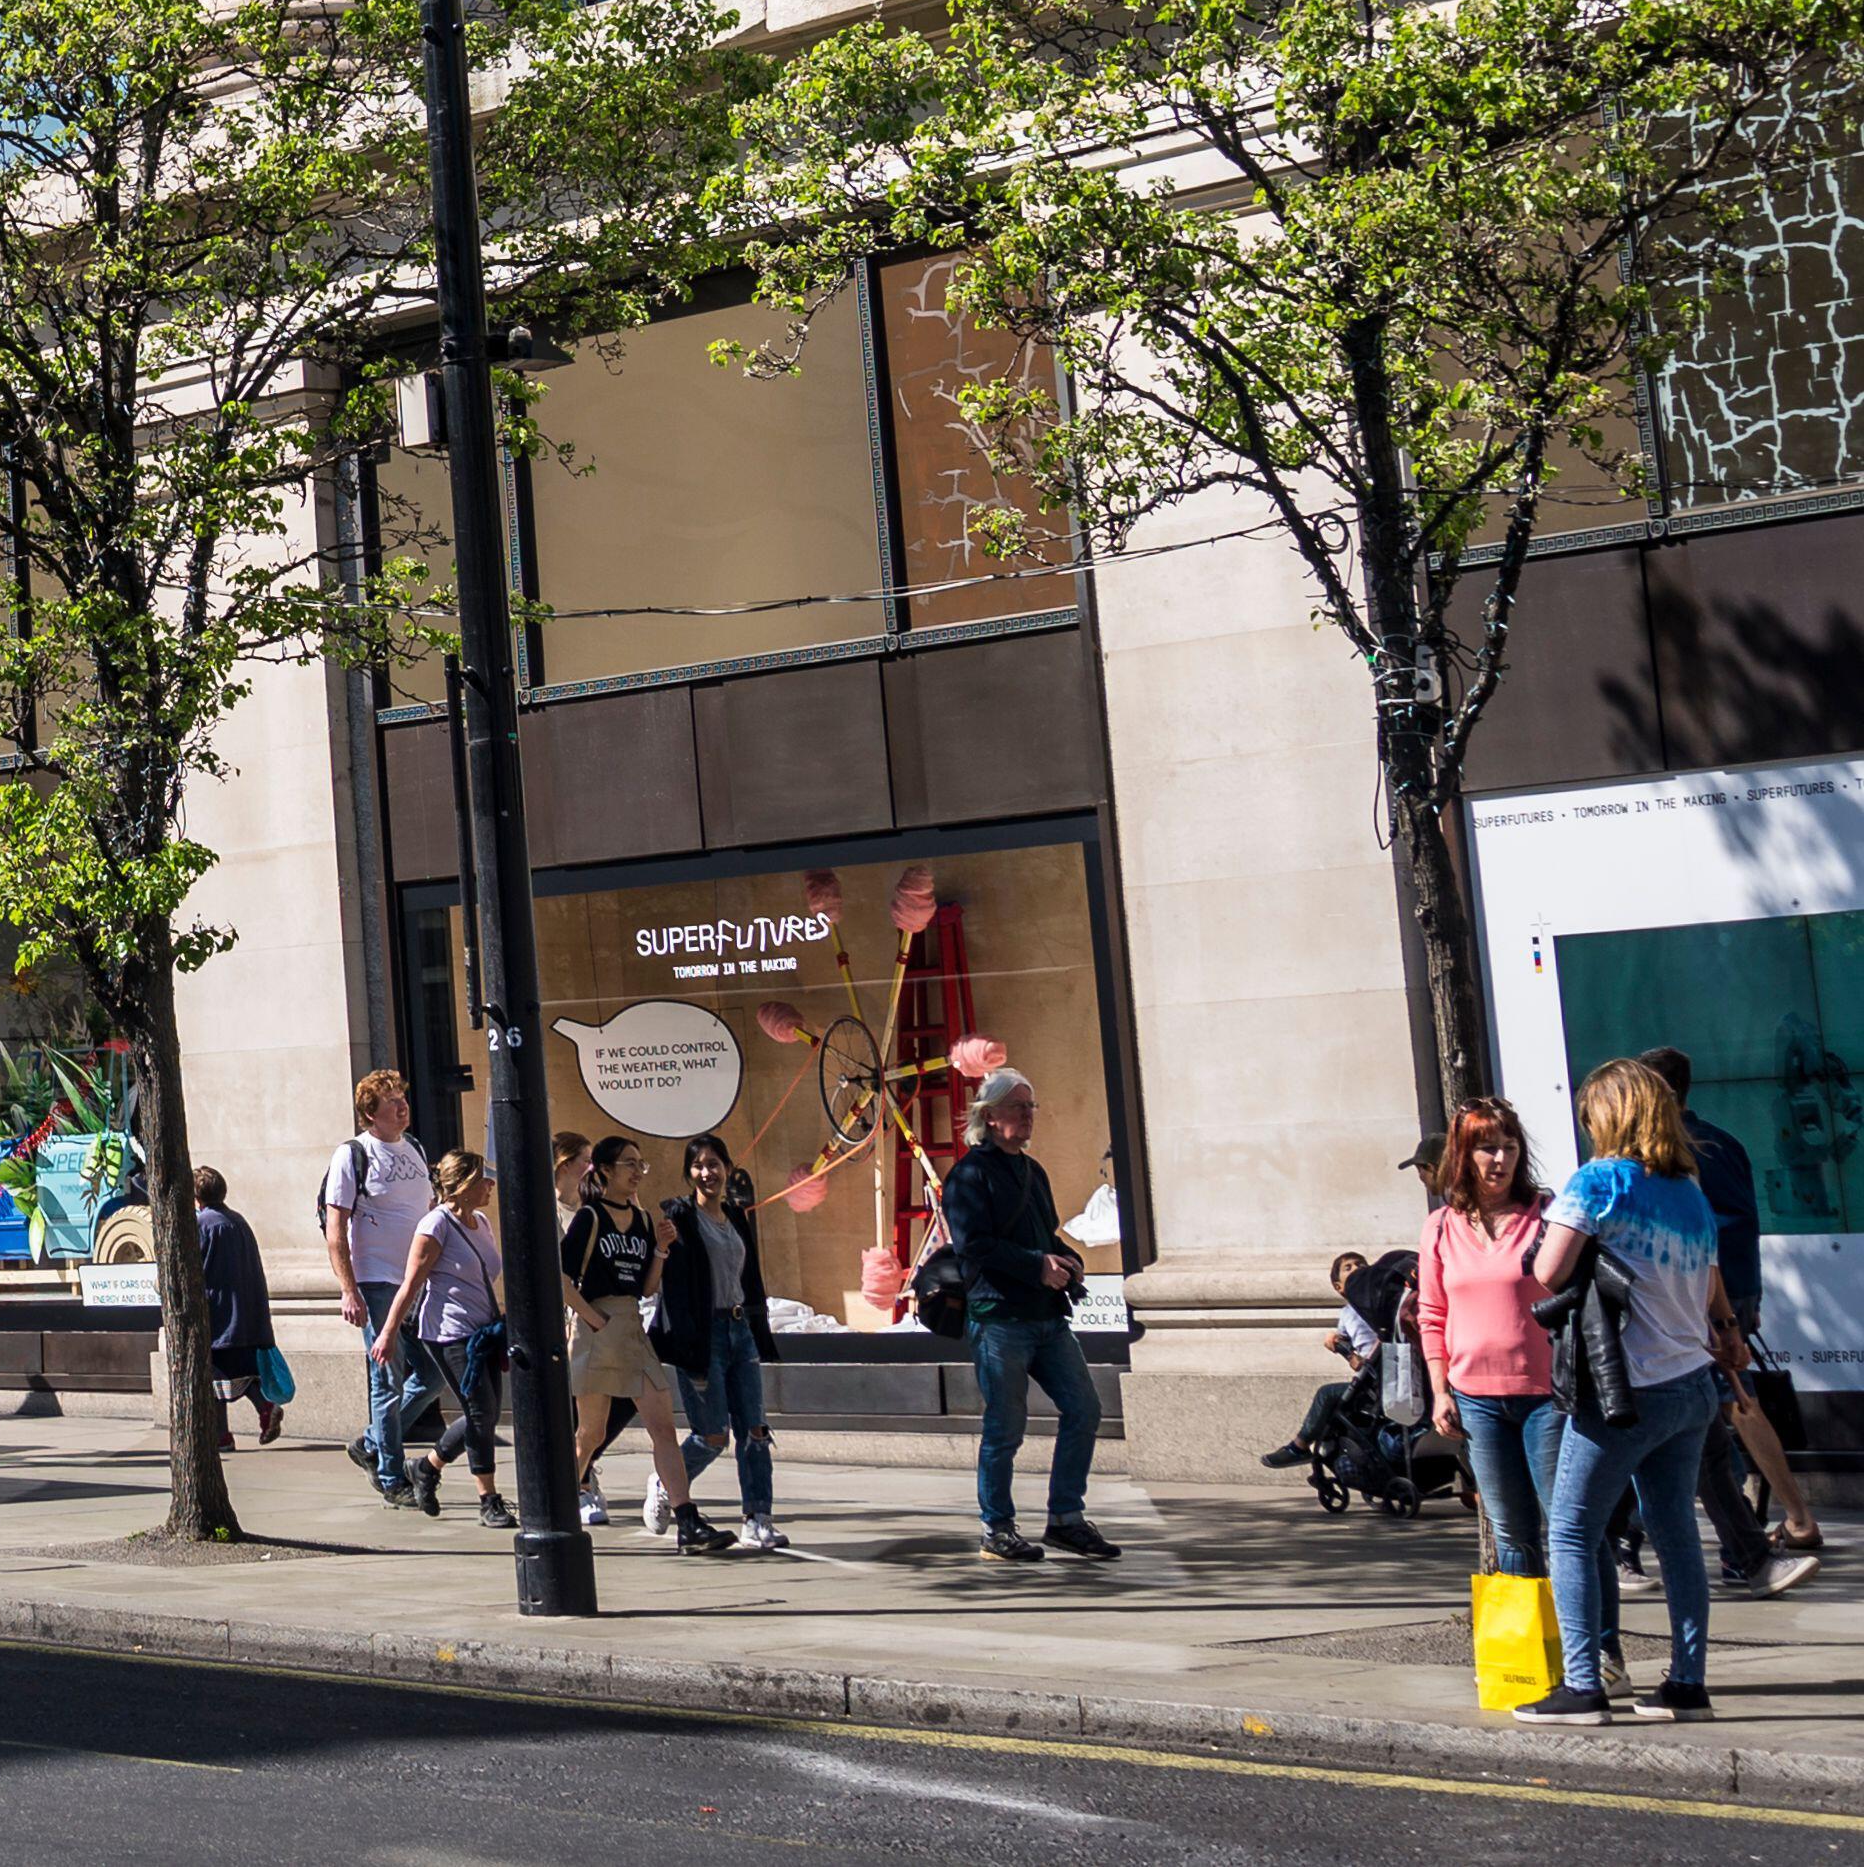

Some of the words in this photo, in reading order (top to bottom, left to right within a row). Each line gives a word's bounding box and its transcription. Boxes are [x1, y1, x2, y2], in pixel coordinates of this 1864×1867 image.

[1473, 810, 1554, 830] SUPERFUTURES
[1574, 803, 1629, 820] TOMORROW
[1635, 800, 1650, 814] IN
[1655, 797, 1677, 811] THE
[1683, 792, 1727, 809] MAKING
[1746, 780, 1835, 802] SUPERFUTURES
[636, 912, 831, 956] SUPERFUTURES
[673, 964, 719, 980] TOMORROW
[722, 962, 736, 976] IN
[739, 960, 757, 974] THE
[761, 957, 797, 973] MAKING
[595, 1048, 605, 1059] IF
[608, 1046, 626, 1058] WE
[629, 1044, 669, 1057] COULD
[672, 1041, 728, 1054] CONTROL
[597, 1063, 620, 1074] THE
[622, 1060, 681, 1073] WEATHER,
[682, 1057, 717, 1070] WHAT
[599, 1078, 643, 1091] WOULD
[645, 1077, 654, 1089] IT
[657, 1075, 682, 1088] DO?
[90, 1280, 110, 1290] WHAT
[121, 1279, 139, 1289] CARS
[92, 1295, 119, 1304] ENERGY
[122, 1294, 136, 1303] AND
[137, 1294, 146, 1303] BE
[1095, 1295, 1124, 1307] COUL
[1503, 1673, 1537, 1686] SELFRIDGES
